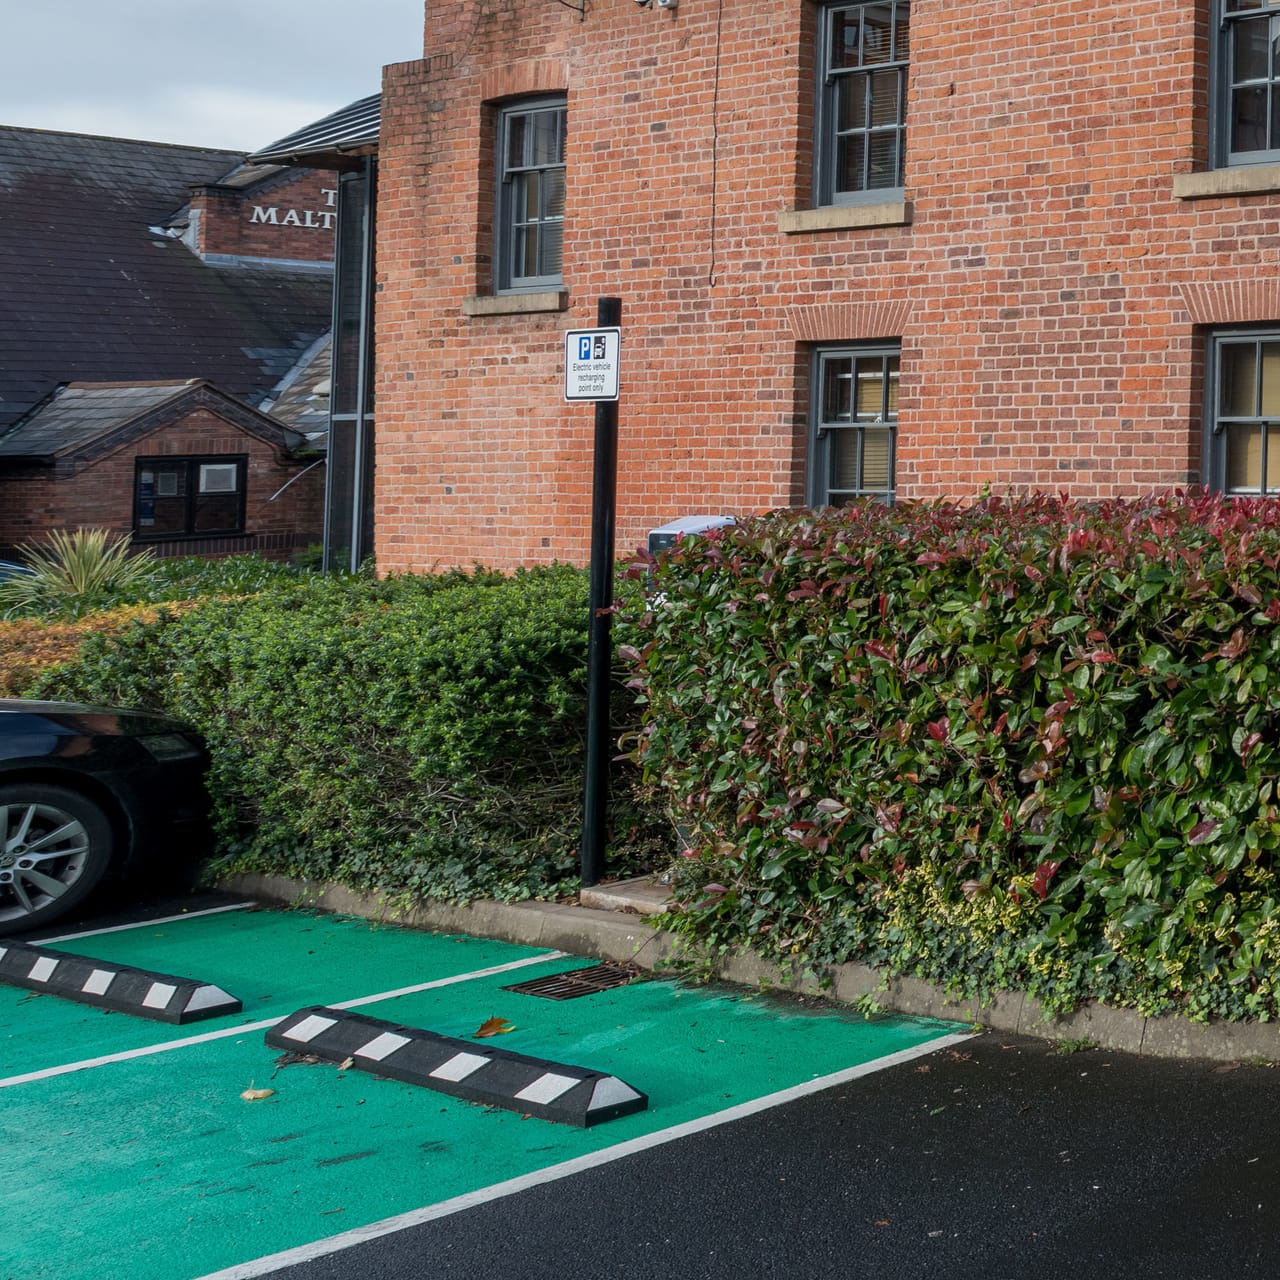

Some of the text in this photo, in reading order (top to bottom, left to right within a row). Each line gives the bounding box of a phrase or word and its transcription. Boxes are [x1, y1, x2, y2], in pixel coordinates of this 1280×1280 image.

[573, 362, 611, 372] Electric vehicle
[578, 374, 605, 383] recharging
[578, 384, 604, 393] point only
